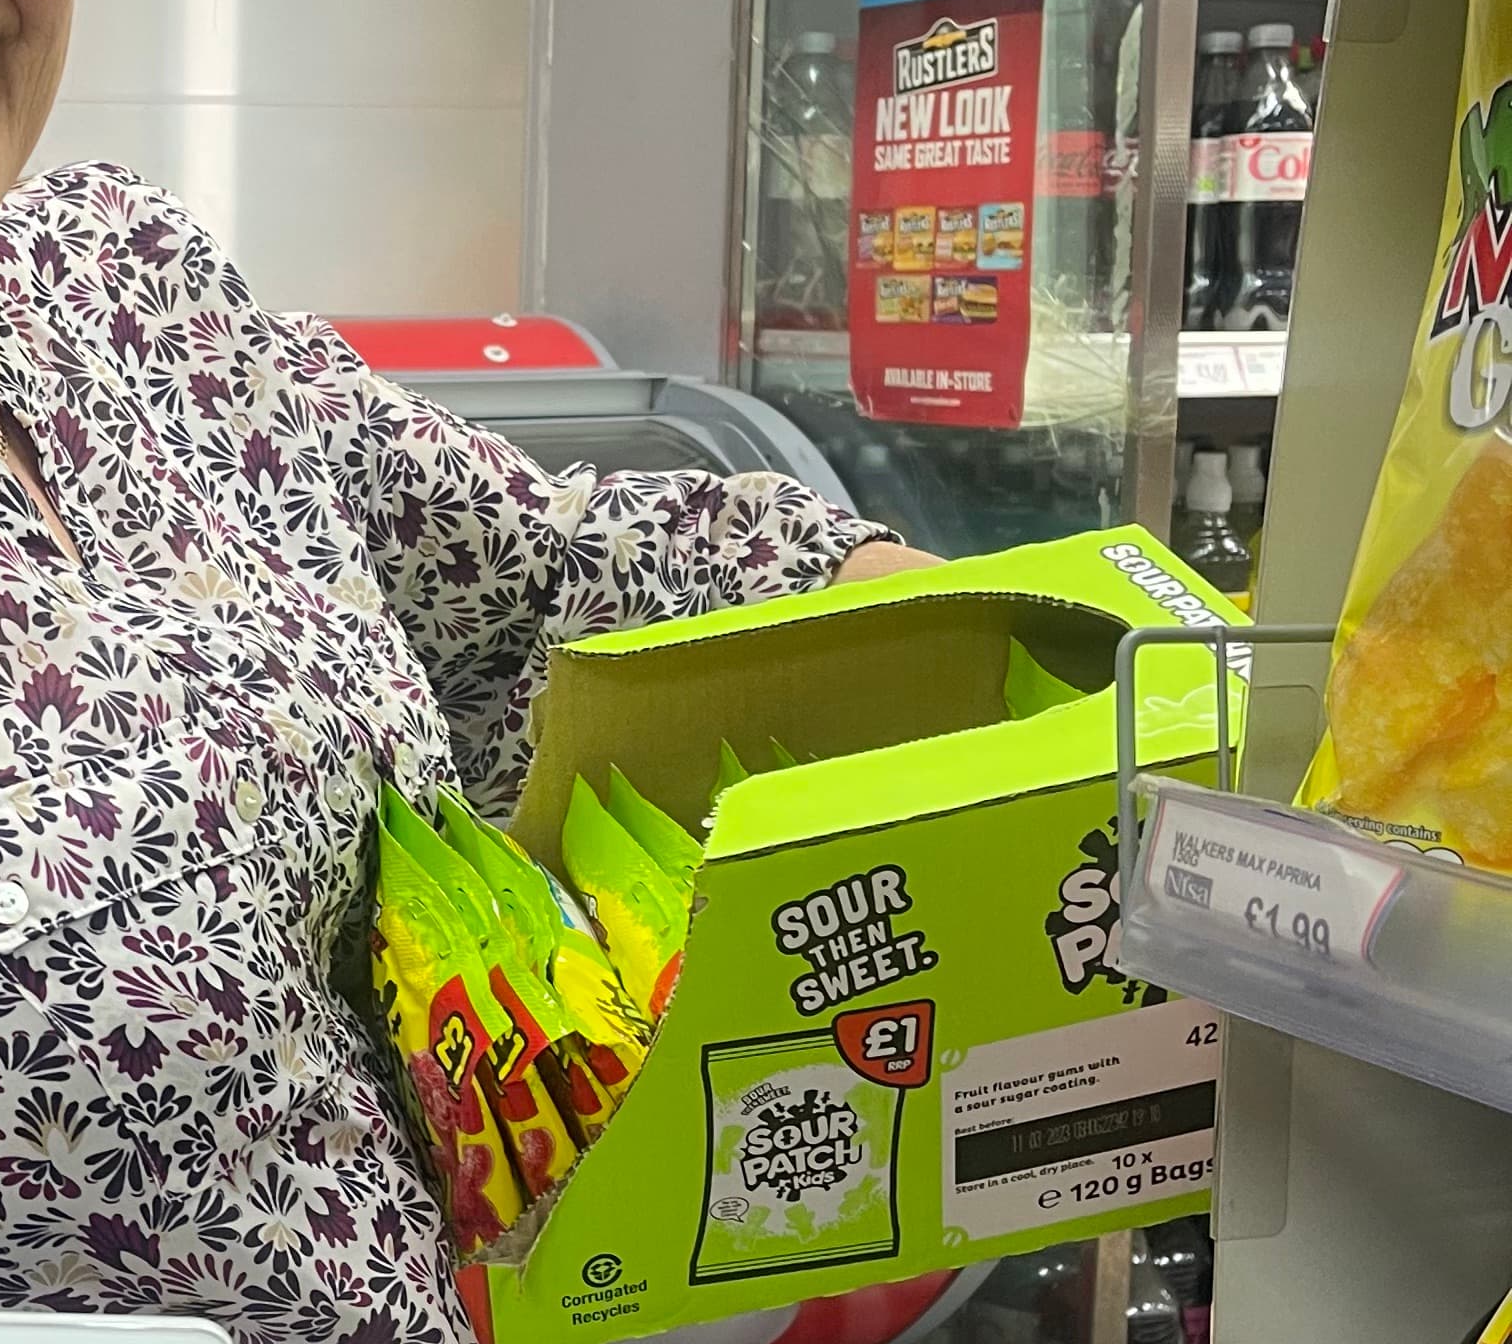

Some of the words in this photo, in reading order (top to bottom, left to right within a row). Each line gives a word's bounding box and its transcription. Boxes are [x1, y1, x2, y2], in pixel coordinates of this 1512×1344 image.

[897, 25, 994, 91] RUSTLERS
[876, 92, 935, 143] NEW
[939, 85, 1012, 138] LOOK
[874, 143, 912, 172] SAME
[915, 140, 962, 169] GREAT
[965, 137, 1011, 167] TASTE
[884, 367, 933, 390] AVAILABLE
[935, 371, 993, 393] IN-STORE
[1101, 543, 1187, 601] SOUR
[1386, 823, 1442, 843] contains:
[1174, 831, 1236, 863] WALKERS
[1235, 850, 1266, 876] MAX
[1267, 858, 1321, 892] PAPRIKA
[1166, 866, 1211, 905] Nisa
[777, 870, 907, 949] SOUR
[808, 921, 886, 967] THEN
[796, 937, 933, 1011] SWEET.
[863, 1015, 919, 1060] £1
[1186, 1022, 1219, 1048] 42
[886, 1057, 912, 1073] RRP
[954, 1085, 989, 1101] Fruit
[992, 1074, 1045, 1093] flavour
[1048, 1064, 1085, 1082] gums
[1088, 1056, 1121, 1071] with
[954, 1105, 964, 1115] a
[966, 1097, 997, 1113] sour
[999, 1086, 1040, 1105] sugar
[1043, 1074, 1101, 1094] coating.
[747, 1111, 858, 1155] SOUR
[954, 1124, 978, 1136] Best
[743, 1140, 863, 1186] PATCH
[793, 1171, 836, 1189] Kids
[955, 1181, 986, 1195] Store
[988, 1178, 999, 1189] in
[1001, 1177, 1009, 1185] a
[1011, 1169, 1038, 1184] cool,
[1039, 1164, 1058, 1178] dry
[1060, 1157, 1094, 1174] place.
[1069, 1177, 1119, 1203] 120
[1126, 1173, 1142, 1195] g
[1150, 1157, 1214, 1187] Bags
[1112, 1151, 1136, 1170] 10
[1141, 1150, 1153, 1164] x
[561, 1278, 648, 1310] Corrugated
[571, 1300, 640, 1327] Recycles
